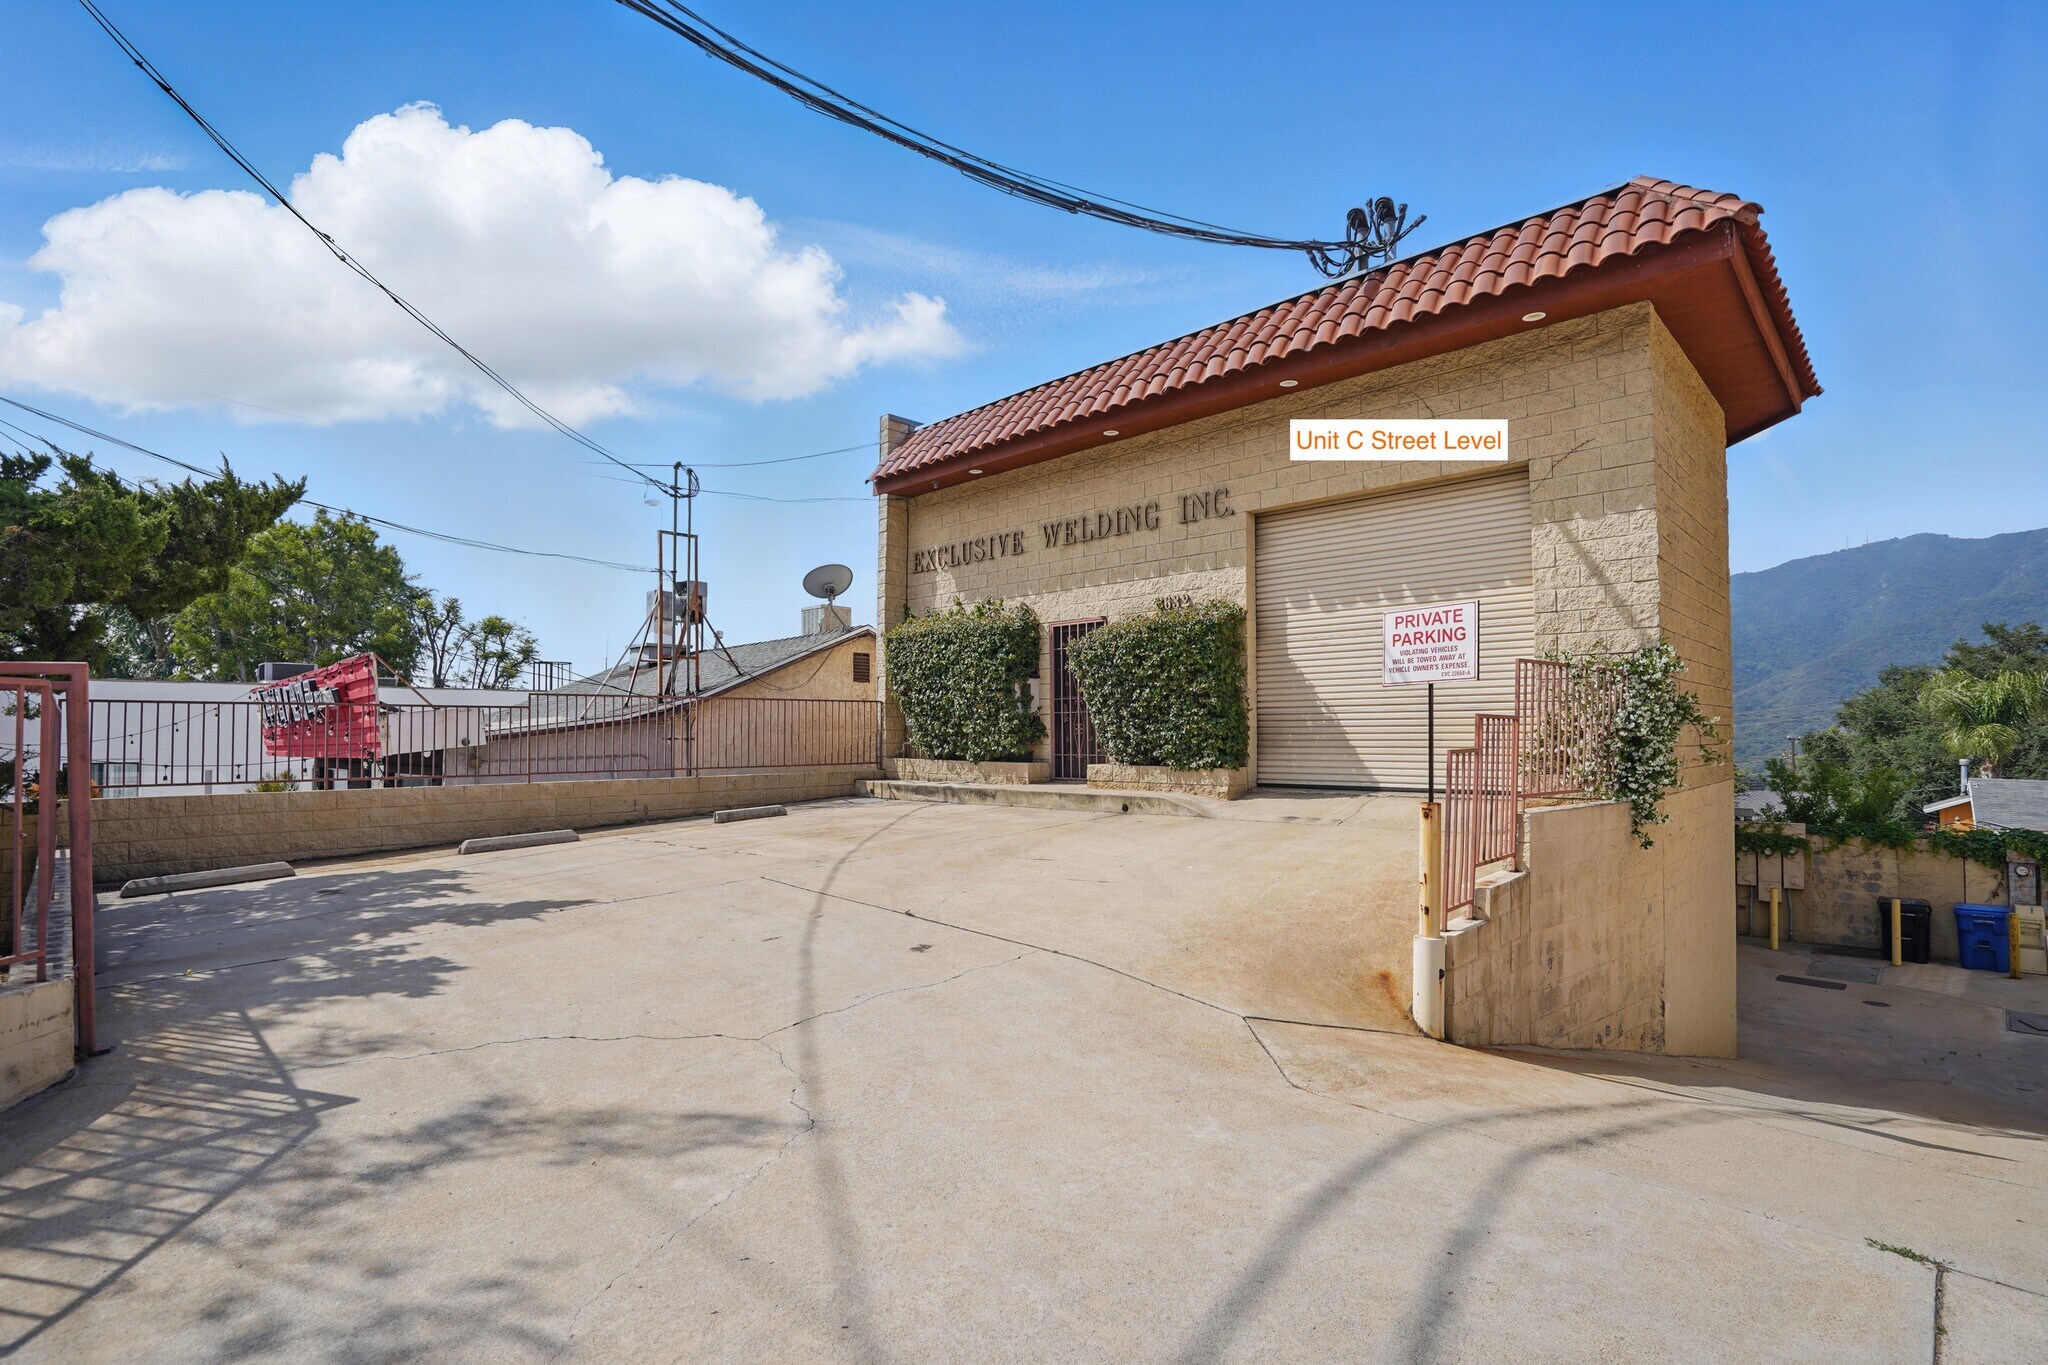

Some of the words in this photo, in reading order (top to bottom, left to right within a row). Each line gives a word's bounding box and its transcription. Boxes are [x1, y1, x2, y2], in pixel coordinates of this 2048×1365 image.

[912, 529, 1025, 574] EXCLUSIVE
[1042, 500, 1160, 549] WELDING
[1178, 487, 1236, 525] INC.
[1394, 608, 1464, 630] PRIVATE
[1392, 626, 1467, 648] PARKING
[1399, 647, 1429, 657] VIOLATING
[1430, 645, 1458, 654] VEHICLES
[1416, 655, 1437, 663] TOWED
[1388, 666, 1411, 674] VEHICLE
[1412, 664, 1439, 672] OWNER'S
[1441, 661, 1470, 670] EXPENSE.
